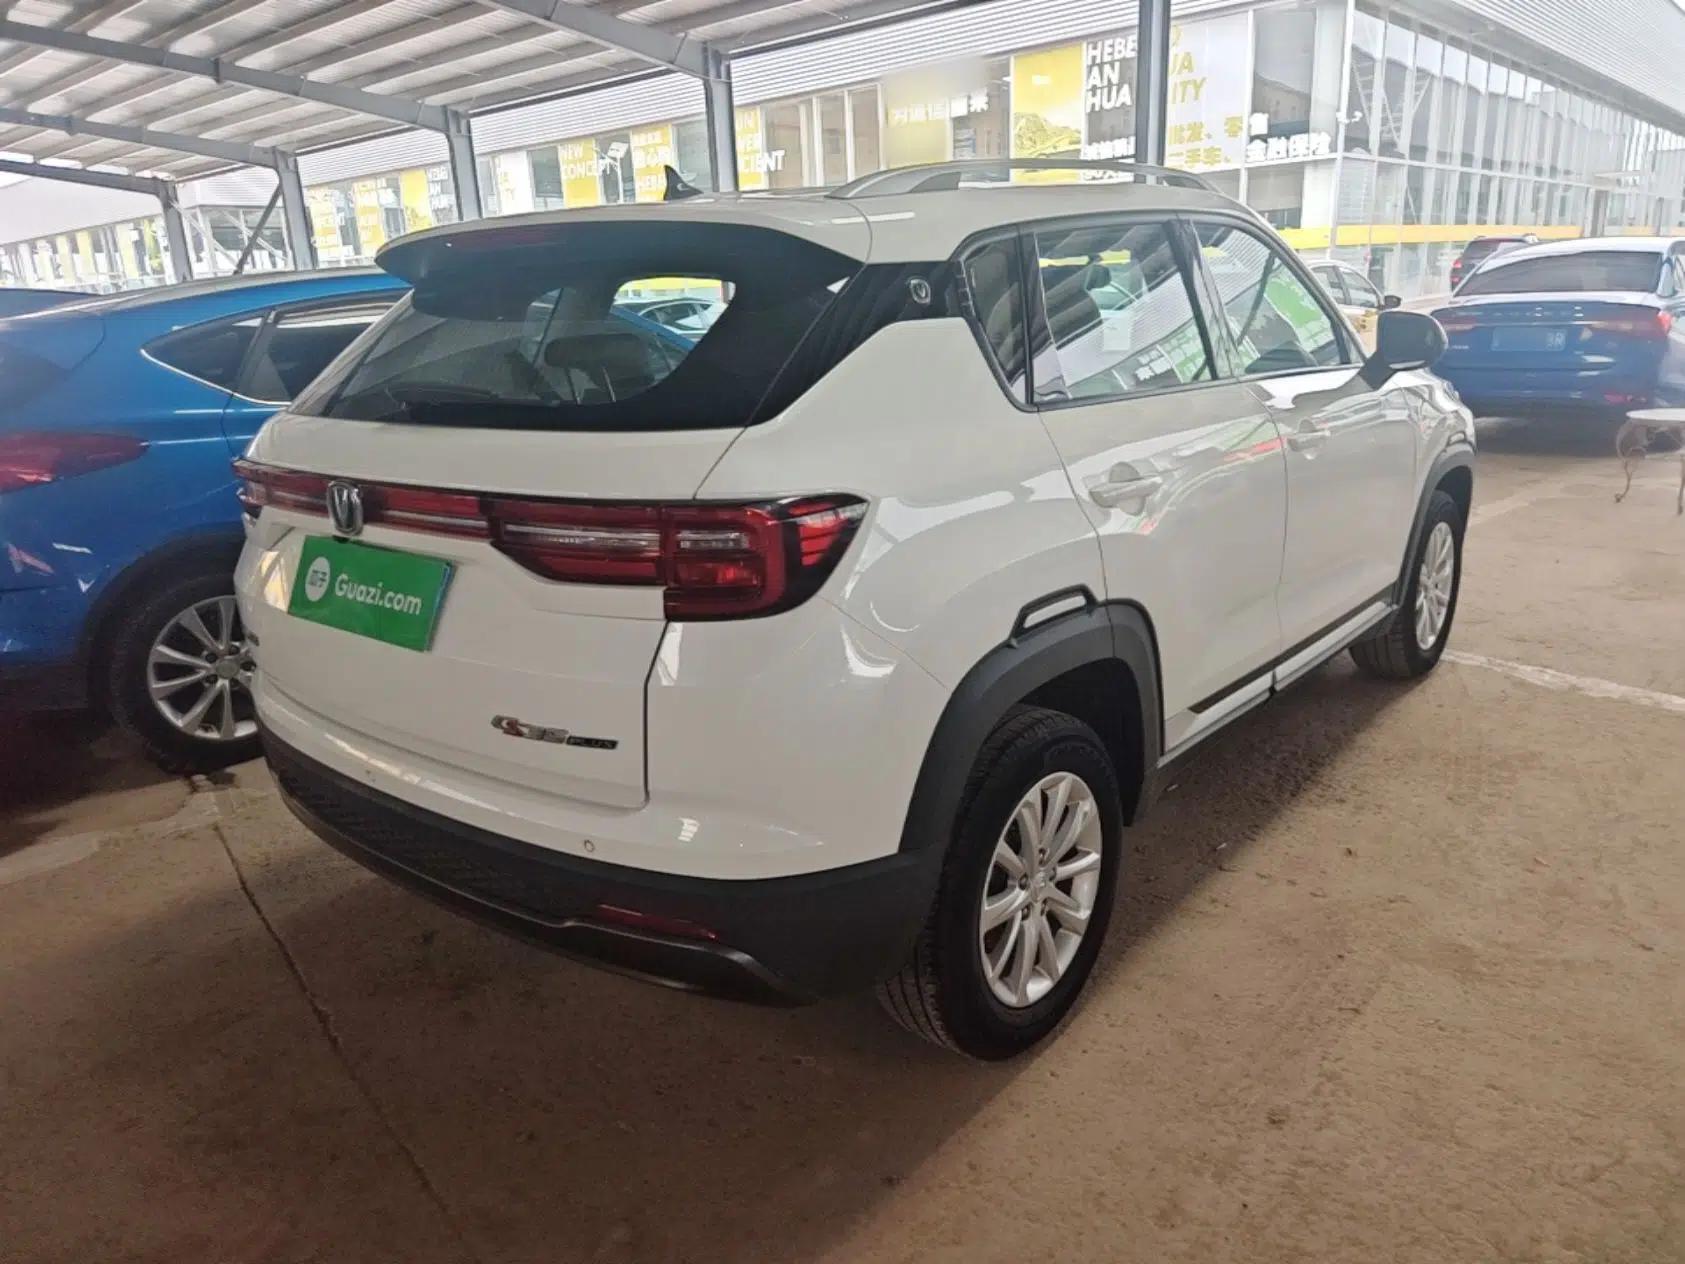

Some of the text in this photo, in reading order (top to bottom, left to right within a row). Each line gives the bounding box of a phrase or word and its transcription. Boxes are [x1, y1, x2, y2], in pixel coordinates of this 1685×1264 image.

[1087, 61, 1121, 91] AN
[1086, 83, 1133, 113] HUA
[334, 573, 422, 616] Guazi.com
